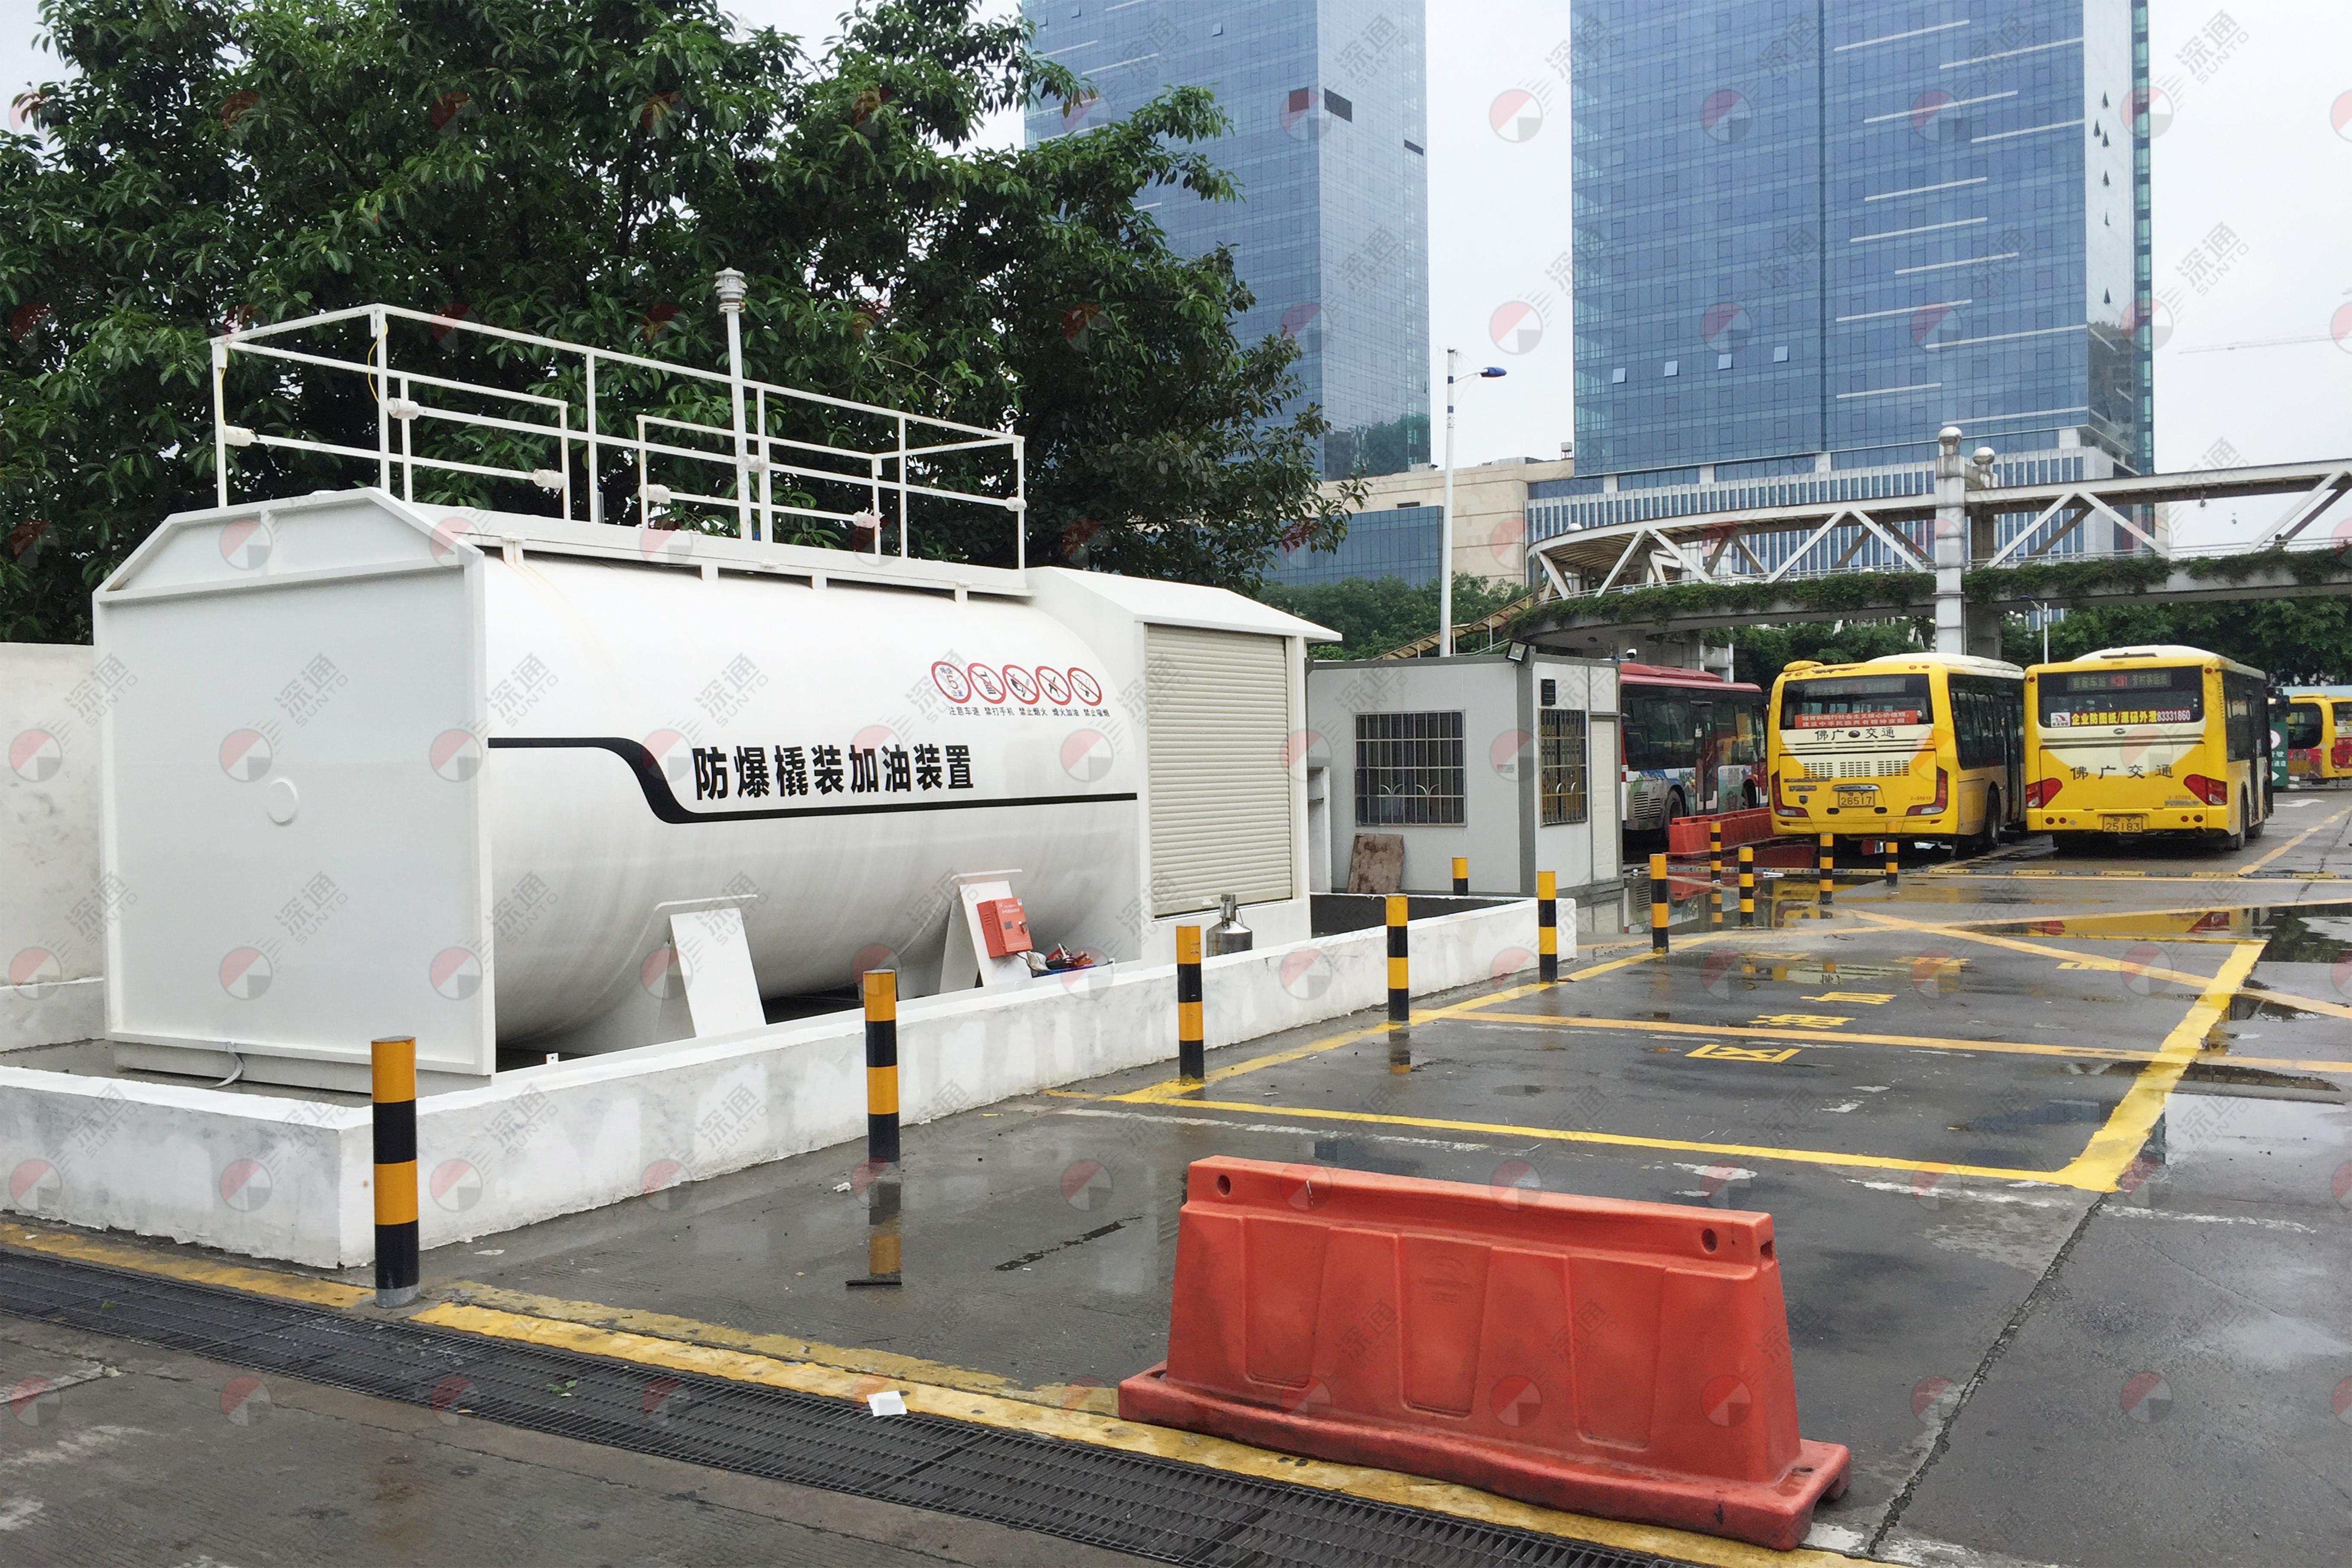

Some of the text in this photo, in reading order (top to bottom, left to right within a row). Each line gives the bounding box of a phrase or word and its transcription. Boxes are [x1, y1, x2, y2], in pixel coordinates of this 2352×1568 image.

[946, 675, 959, 689] 5
[949, 707, 980, 716] 注意车速
[984, 707, 1014, 716] 禁打手机
[1019, 707, 1048, 716] 禁止烟火
[1084, 709, 1110, 717] 禁止吸烟
[692, 745, 974, 800] 防爆橇装加油装置
[2070, 764, 2174, 781] 佛广交通
[1841, 796, 1872, 805] 28517
[2106, 822, 2140, 831] 25183
